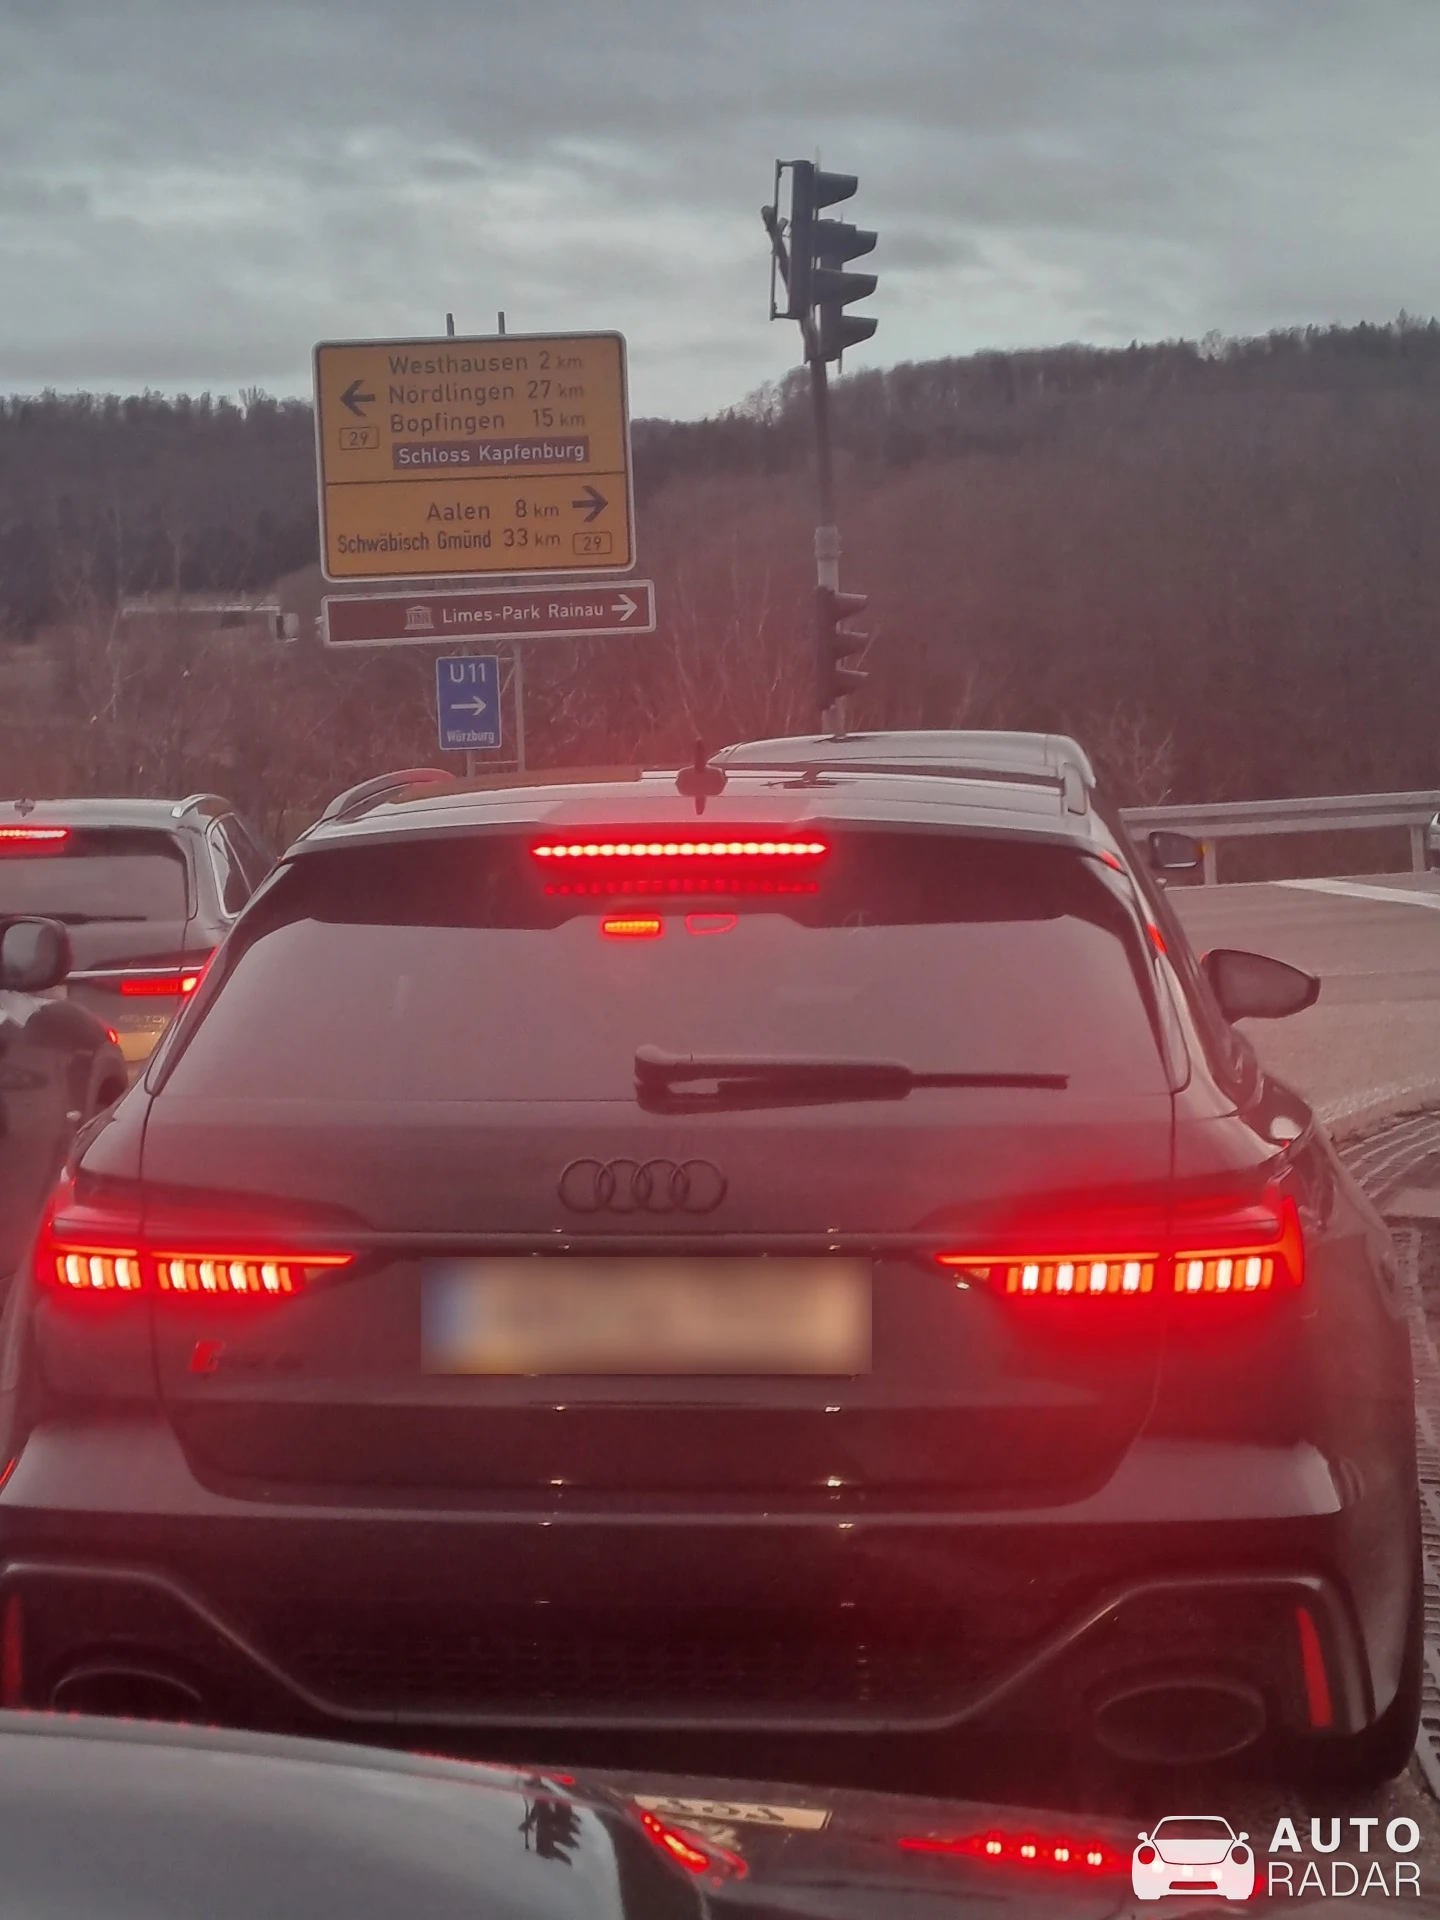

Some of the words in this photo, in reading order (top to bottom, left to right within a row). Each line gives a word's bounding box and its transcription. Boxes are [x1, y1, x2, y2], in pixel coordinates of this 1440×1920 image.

[388, 354, 528, 375] Westhausen
[539, 351, 551, 369] 2
[557, 353, 582, 368] km
[388, 382, 515, 405] Nördlingen
[527, 380, 551, 398] 27
[558, 382, 584, 397] km
[390, 412, 505, 436] Bopfingen
[532, 408, 554, 427] 15
[560, 411, 585, 427] km
[349, 431, 368, 446] 29
[398, 445, 470, 464] Schloss
[479, 443, 585, 462] Kapfenburg
[427, 501, 491, 521] Aalen
[515, 499, 527, 517] 8
[534, 502, 559, 517] km
[337, 533, 429, 553] Schwäbisch
[437, 530, 491, 549] Gmünd
[503, 529, 528, 547] 33
[535, 531, 560, 546] km
[583, 536, 602, 550] 29
[442, 605, 540, 624] Limes-Park
[548, 603, 603, 618] Rainau
[447, 729, 495, 744] Würzburg
